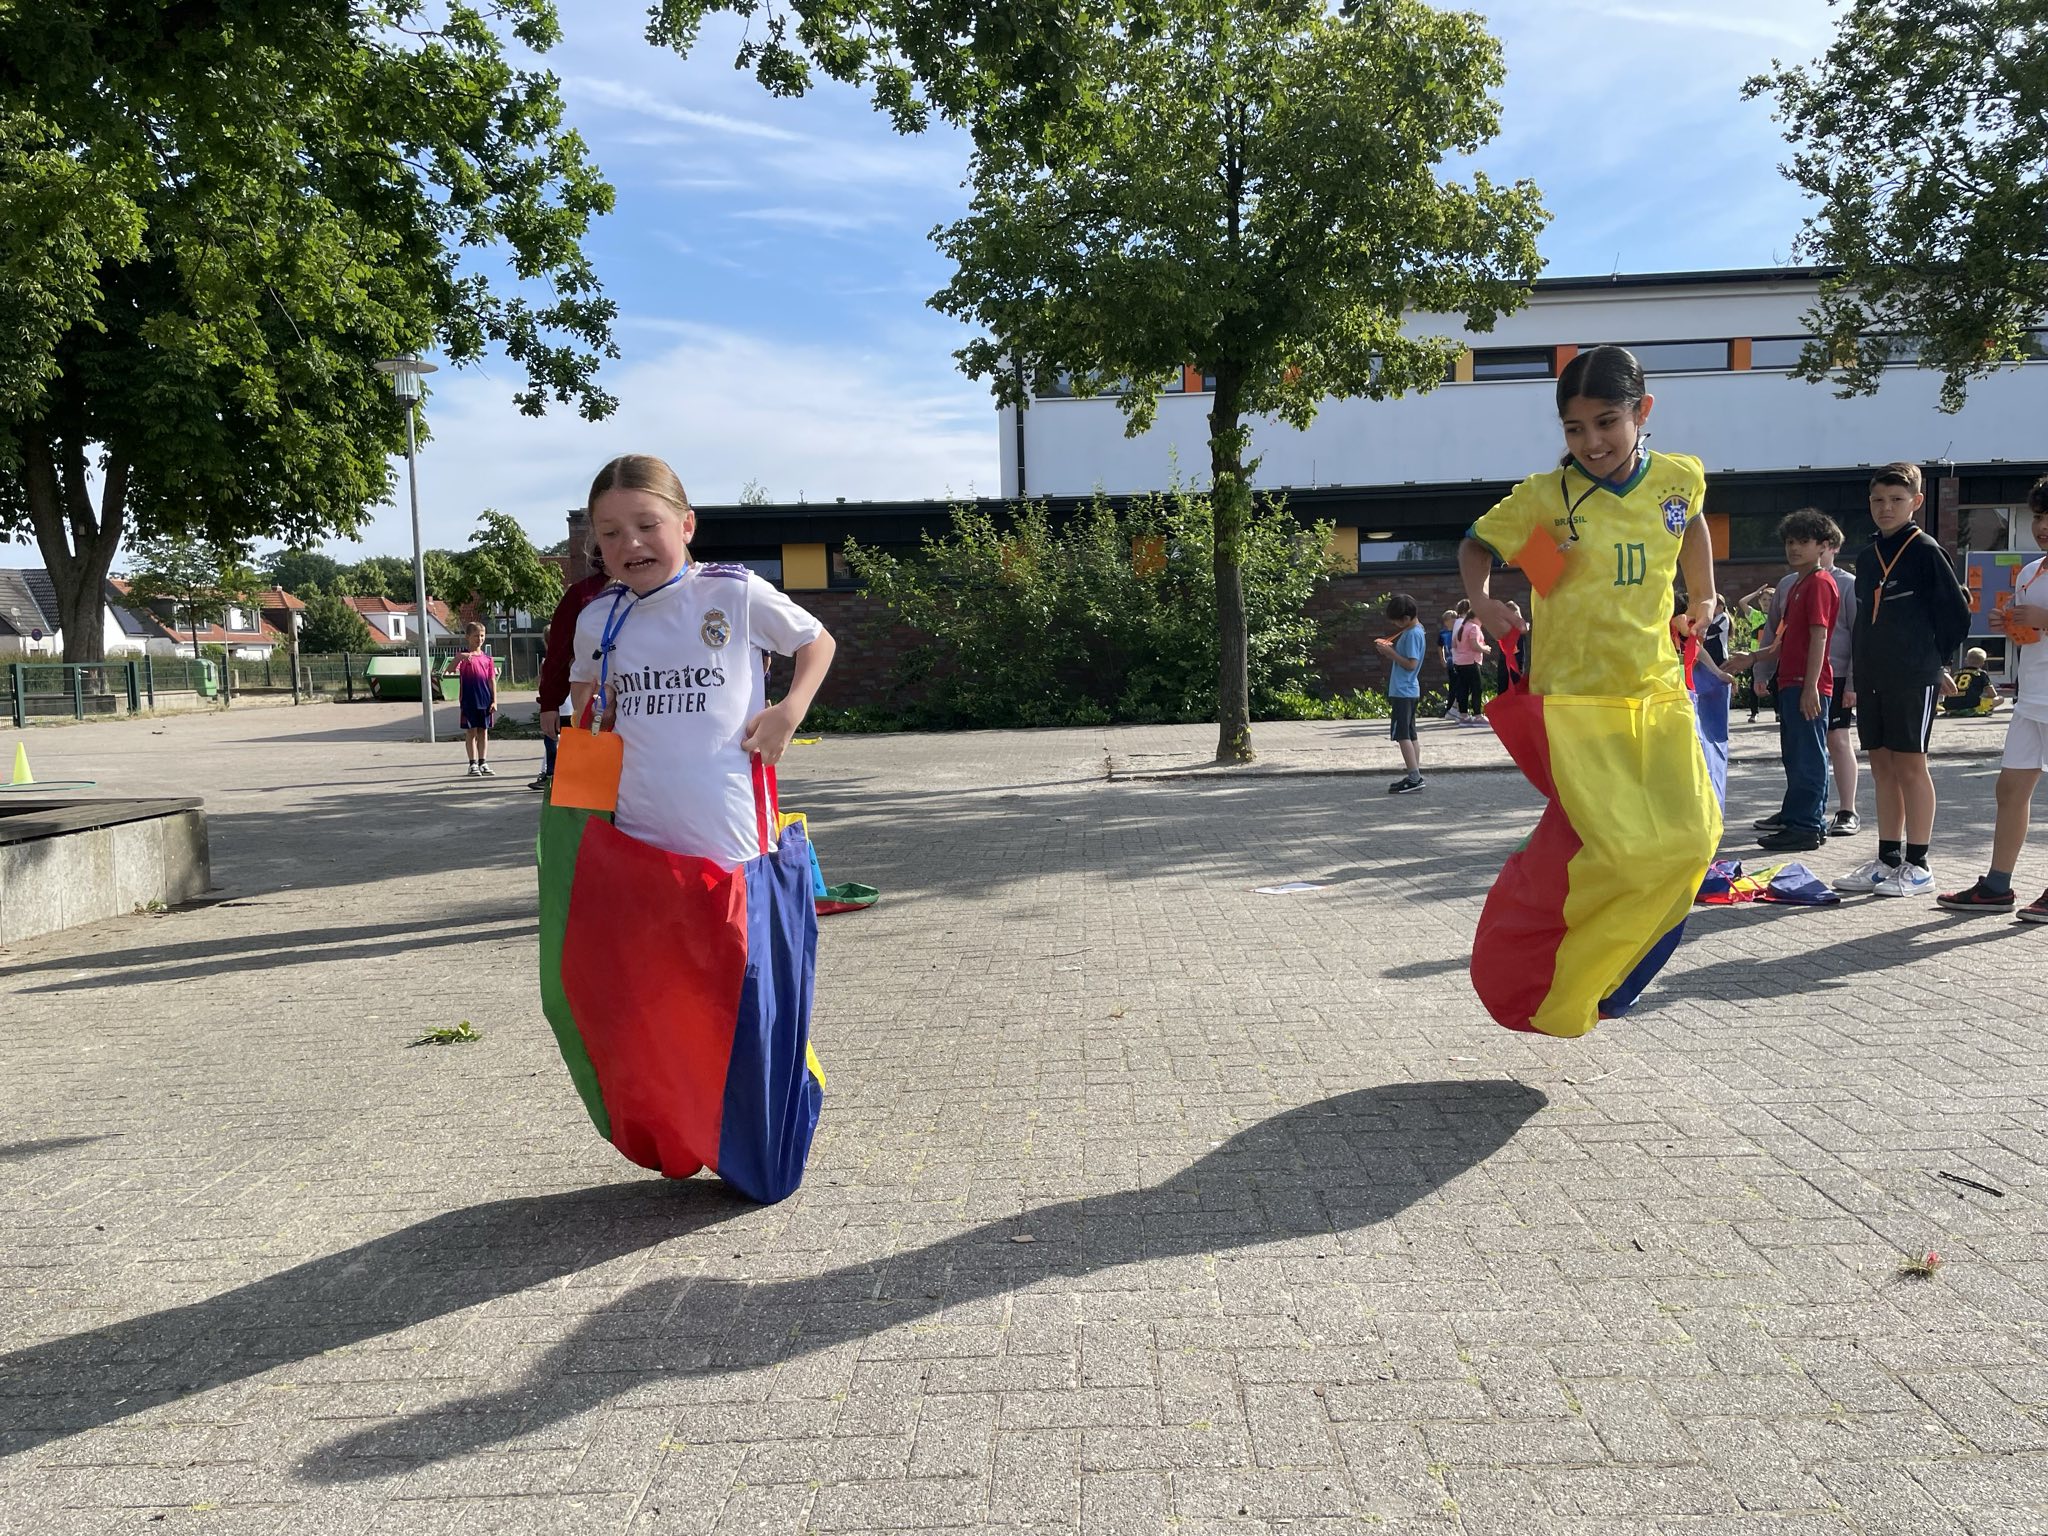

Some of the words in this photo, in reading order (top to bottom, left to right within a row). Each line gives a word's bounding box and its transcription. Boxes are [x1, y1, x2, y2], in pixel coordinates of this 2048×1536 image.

[1613, 543, 1646, 586] 10
[613, 665, 725, 695] Emirates
[621, 696, 641, 716] FLY
[646, 692, 706, 715] BETTER
